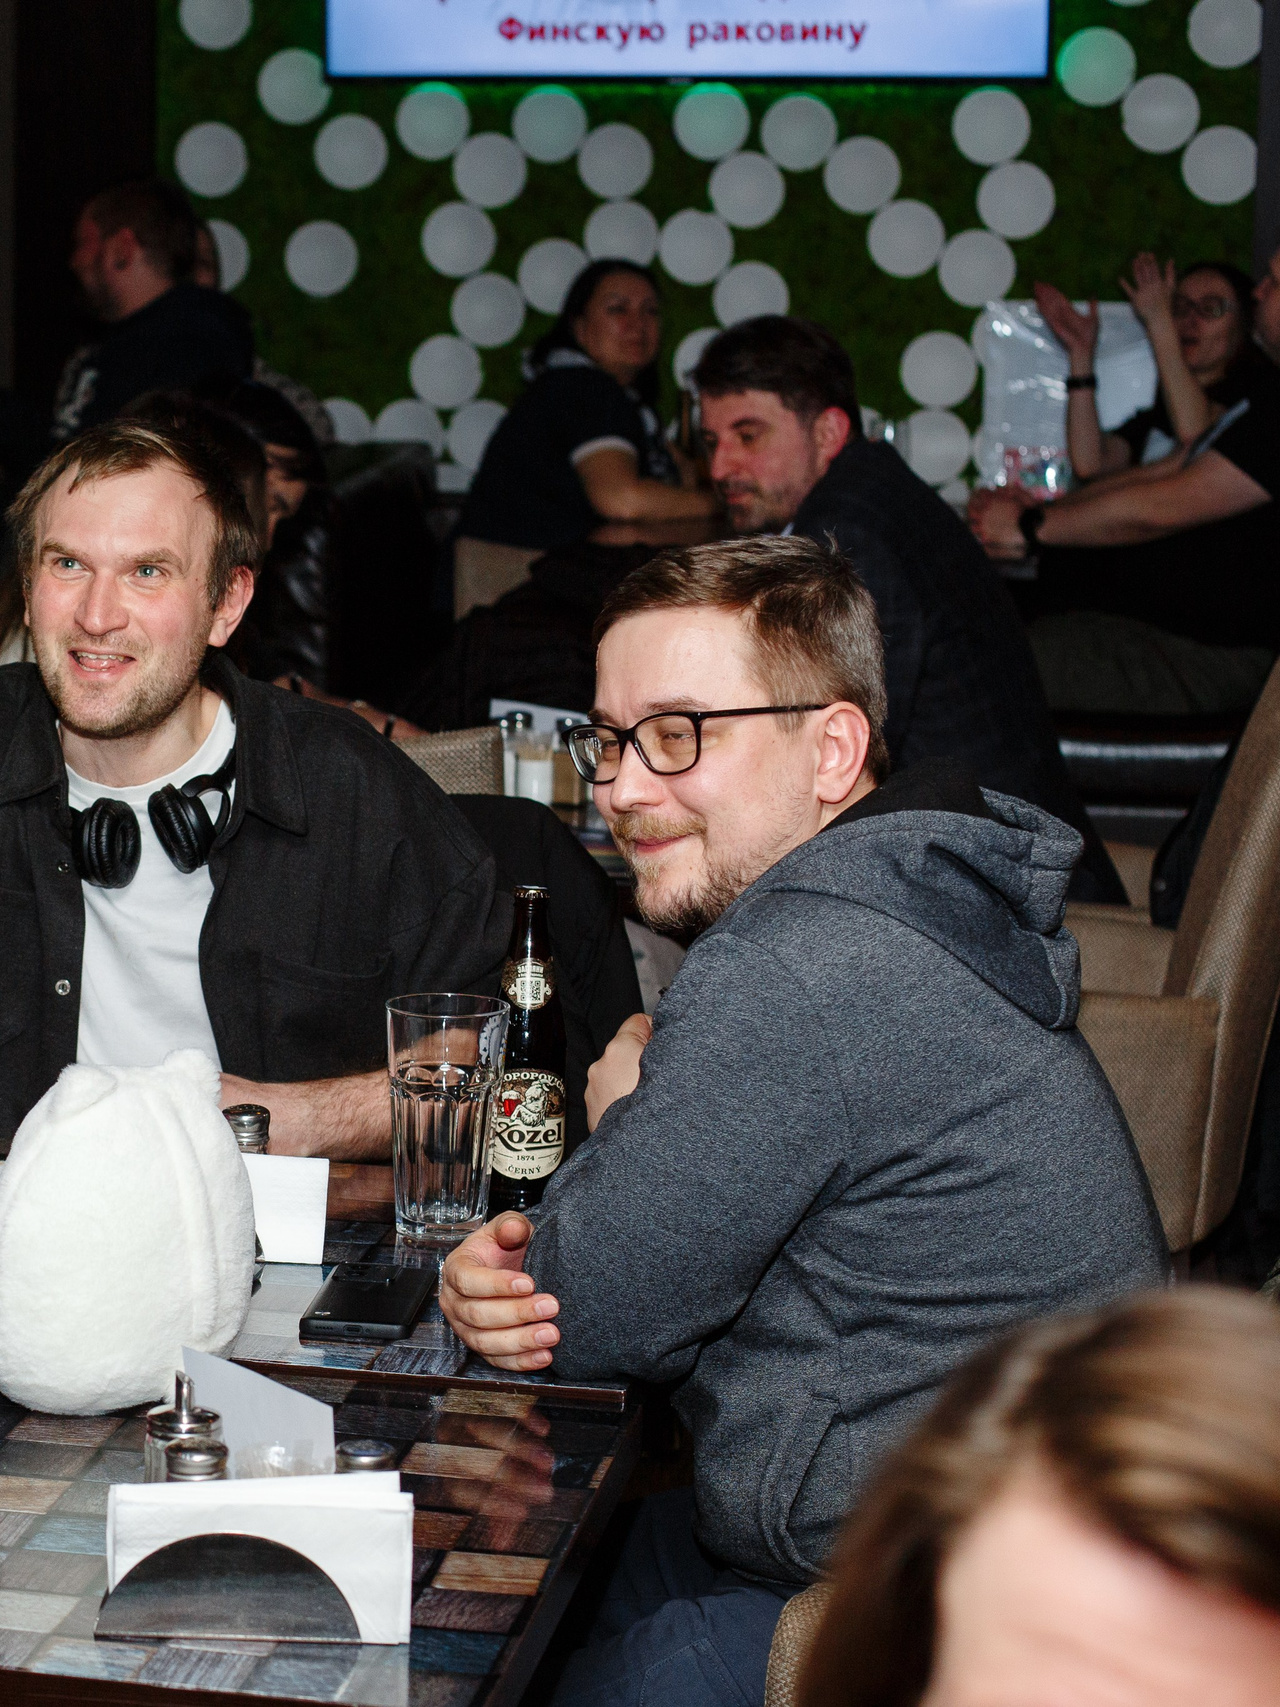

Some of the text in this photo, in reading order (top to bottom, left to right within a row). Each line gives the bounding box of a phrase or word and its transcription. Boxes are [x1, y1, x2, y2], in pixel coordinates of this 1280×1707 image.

[498, 17, 867, 51] Финскую раковину
[507, 1164, 542, 1175] ČERNÝ
